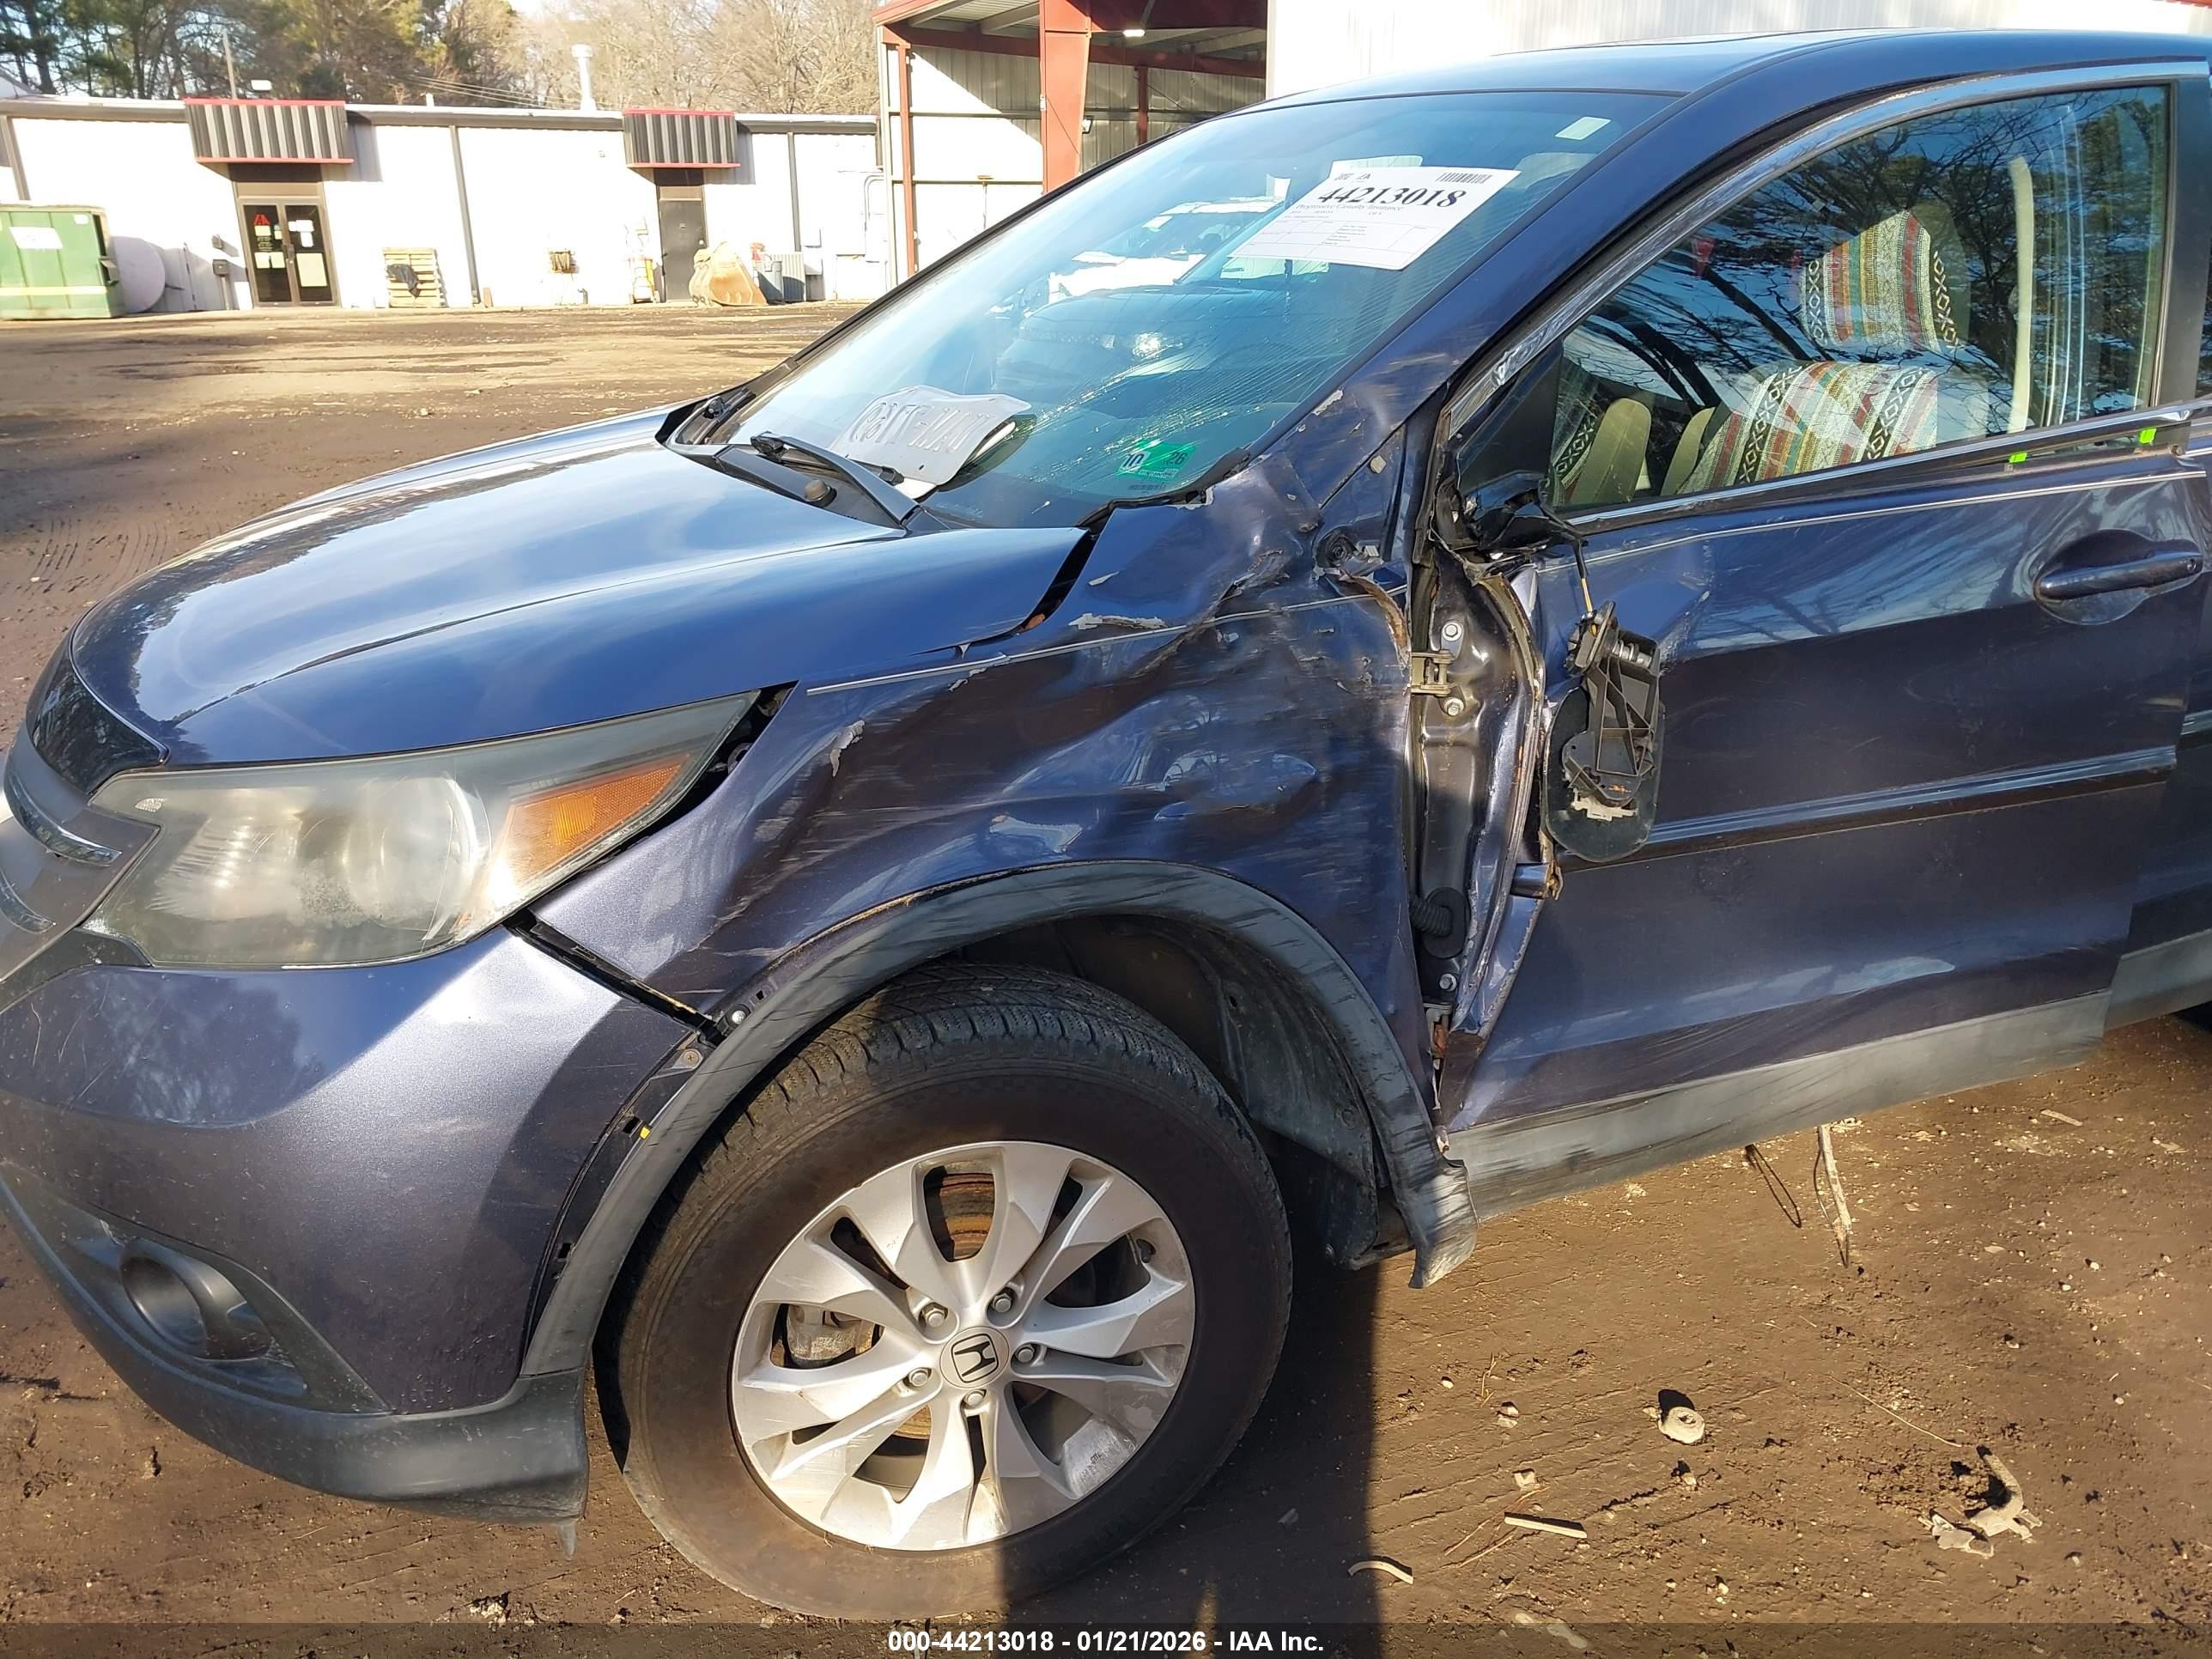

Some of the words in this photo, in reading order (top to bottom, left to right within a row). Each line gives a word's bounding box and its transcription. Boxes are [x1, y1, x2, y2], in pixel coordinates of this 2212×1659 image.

[1318, 186, 1467, 208] 44213018
[1122, 453, 1145, 468] 10
[1168, 451, 1188, 465] 26
